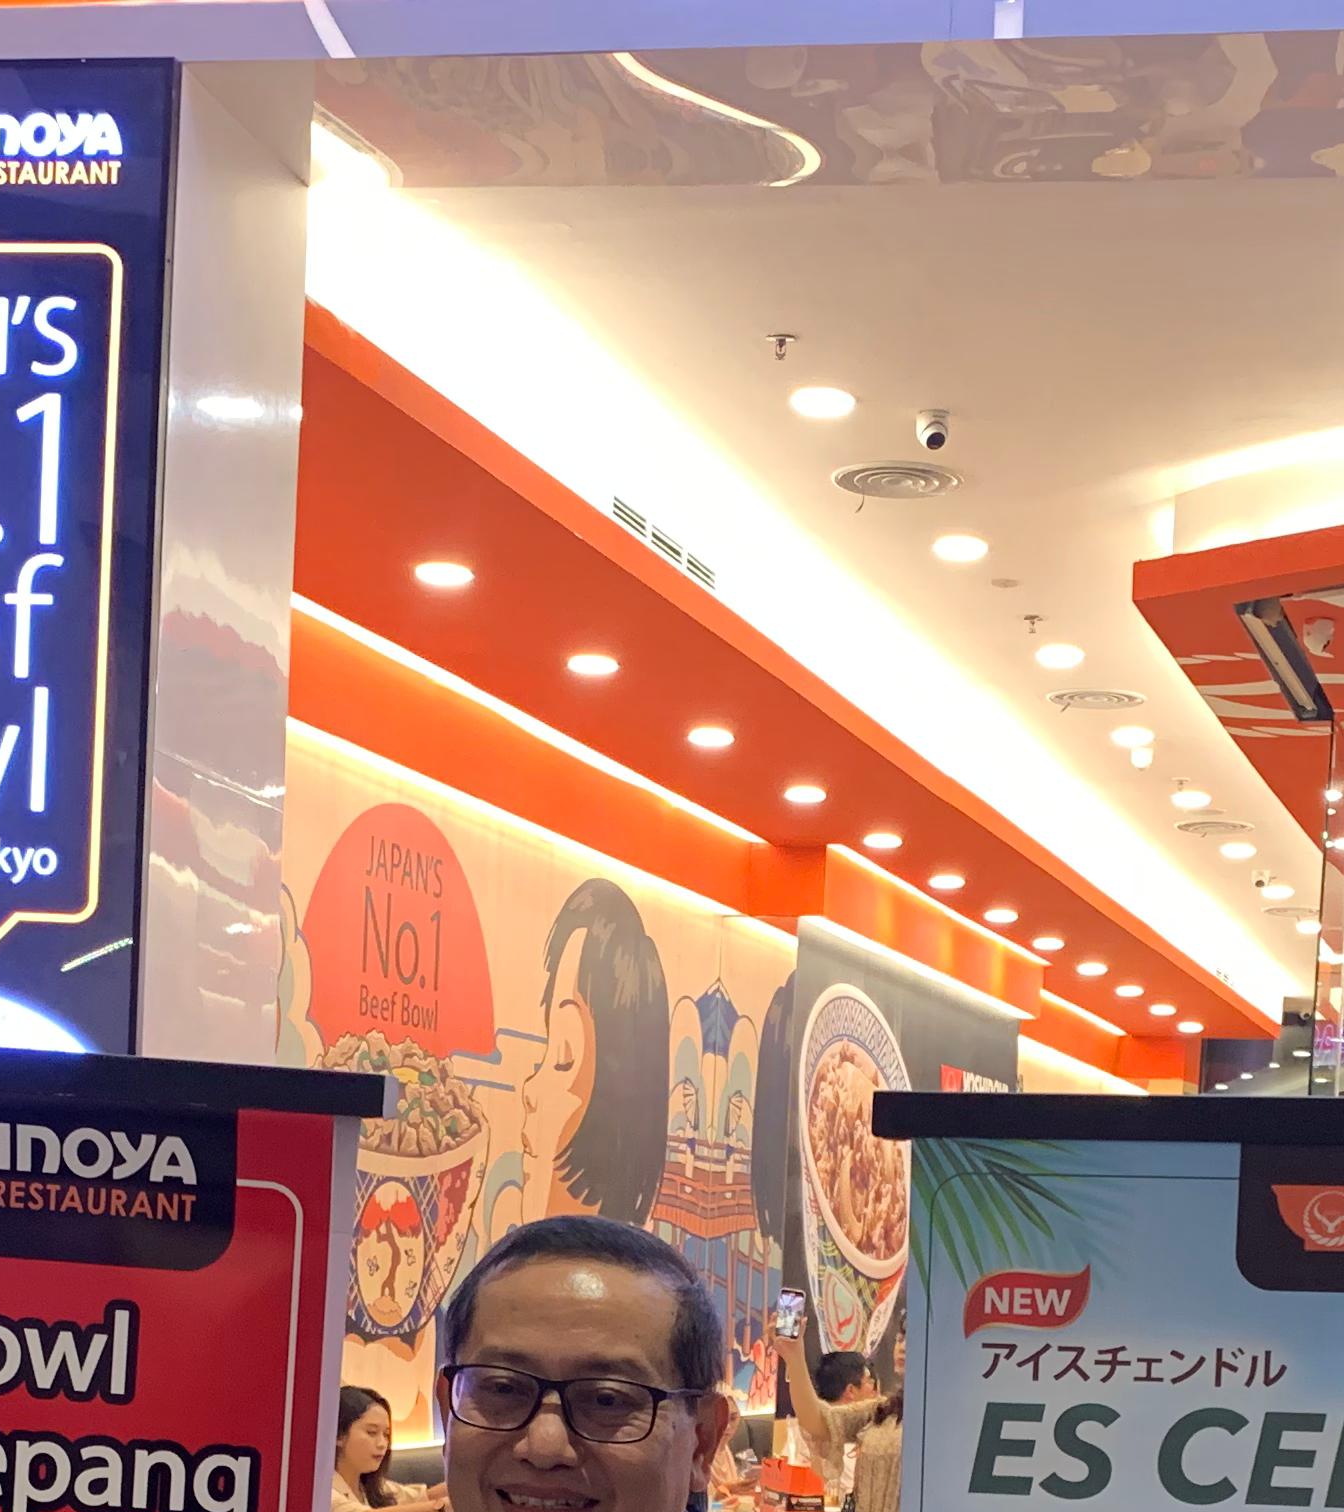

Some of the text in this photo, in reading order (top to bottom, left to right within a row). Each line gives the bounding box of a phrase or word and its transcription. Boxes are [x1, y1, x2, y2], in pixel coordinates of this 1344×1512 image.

[365, 835, 443, 898] JAPAN'S
[362, 885, 441, 992] No.1
[359, 984, 438, 1032] Beef Bowl
[982, 1285, 1072, 1317] NEW
[980, 1341, 1288, 1388] アイスチェンドル
[967, 1402, 1125, 1500] ES
